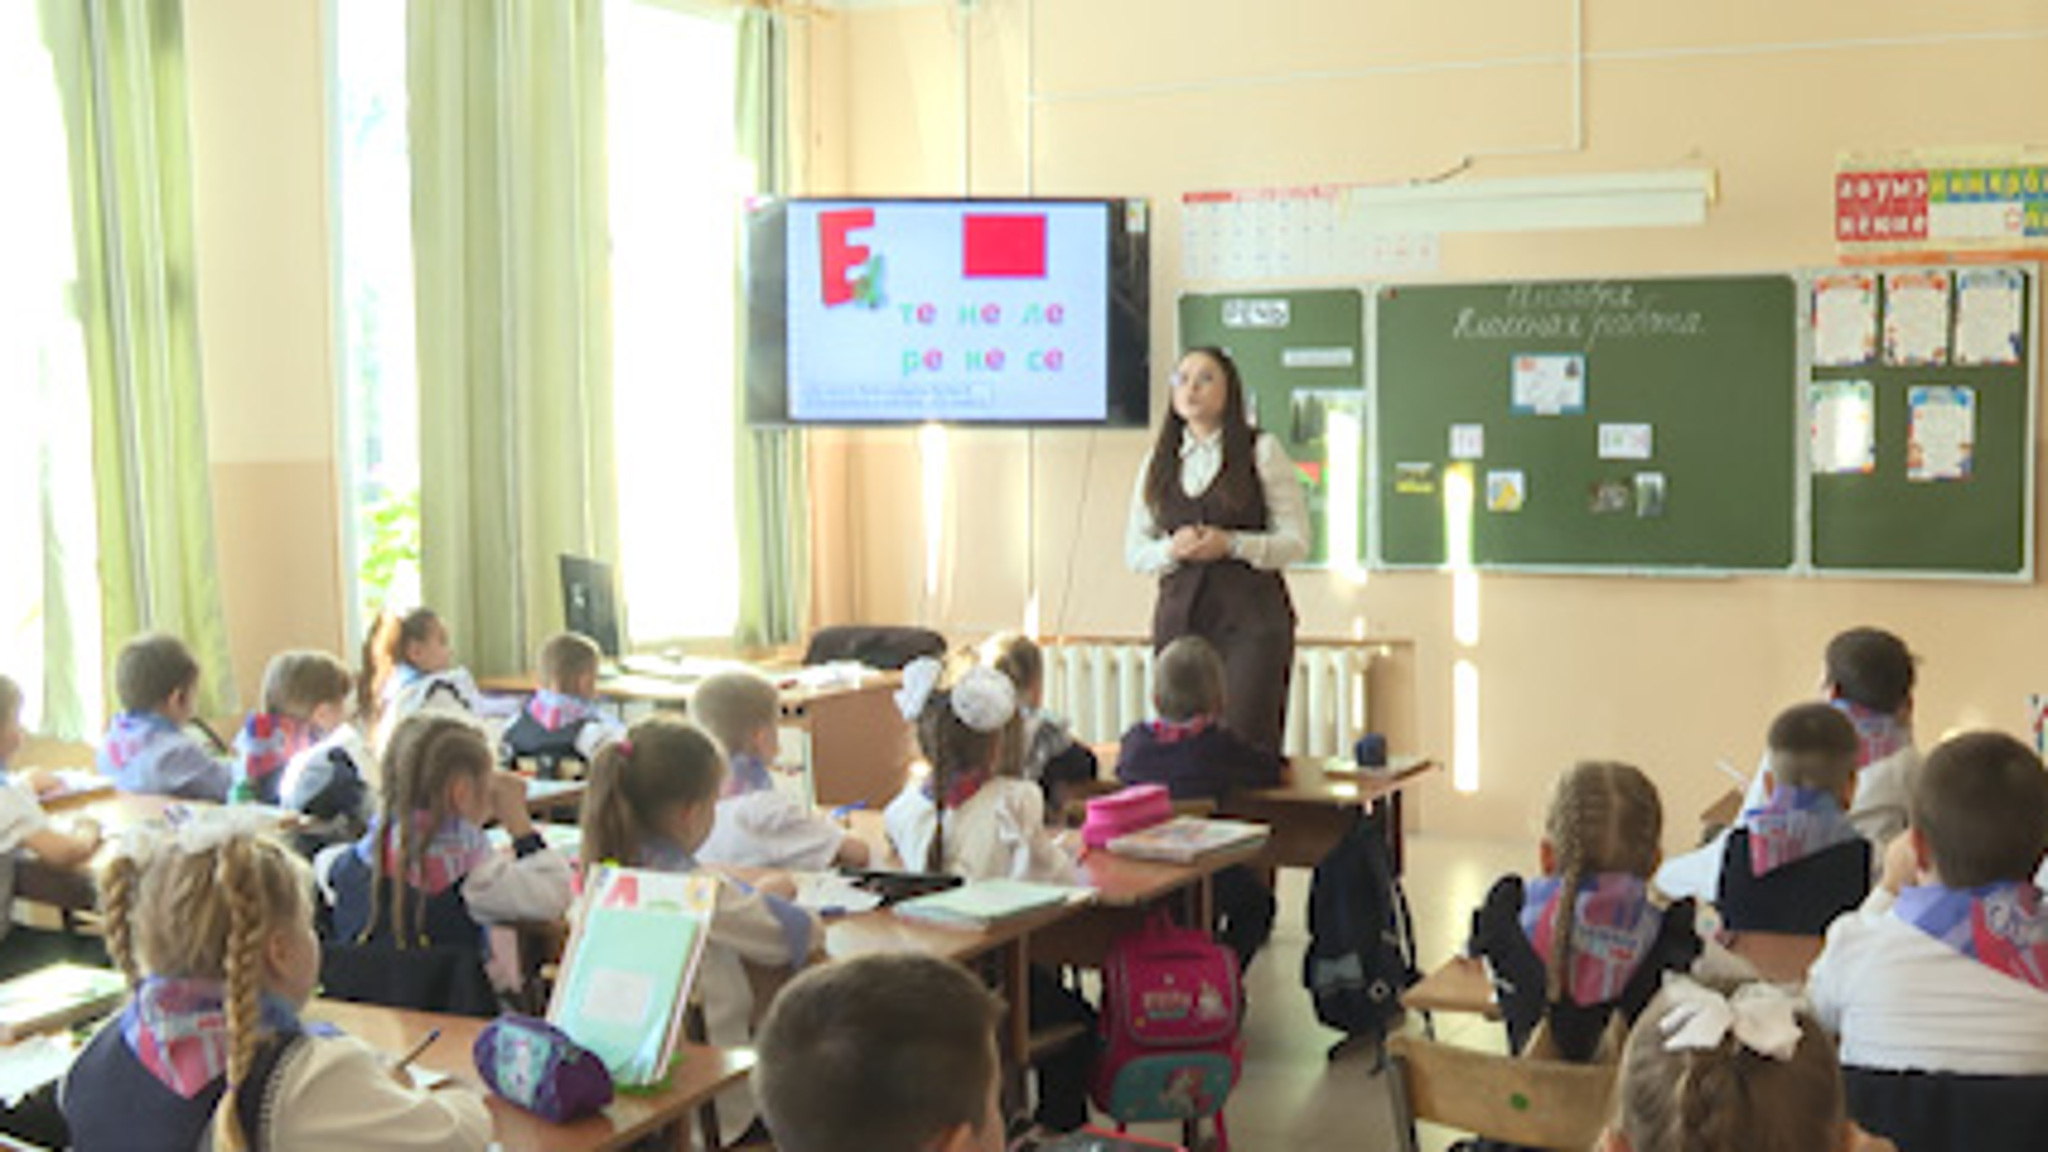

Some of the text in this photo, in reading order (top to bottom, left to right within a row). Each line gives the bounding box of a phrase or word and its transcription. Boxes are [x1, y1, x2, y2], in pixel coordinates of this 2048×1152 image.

[900, 303, 936, 325] те
[902, 348, 943, 375] ре
[1026, 348, 1065, 372] се
